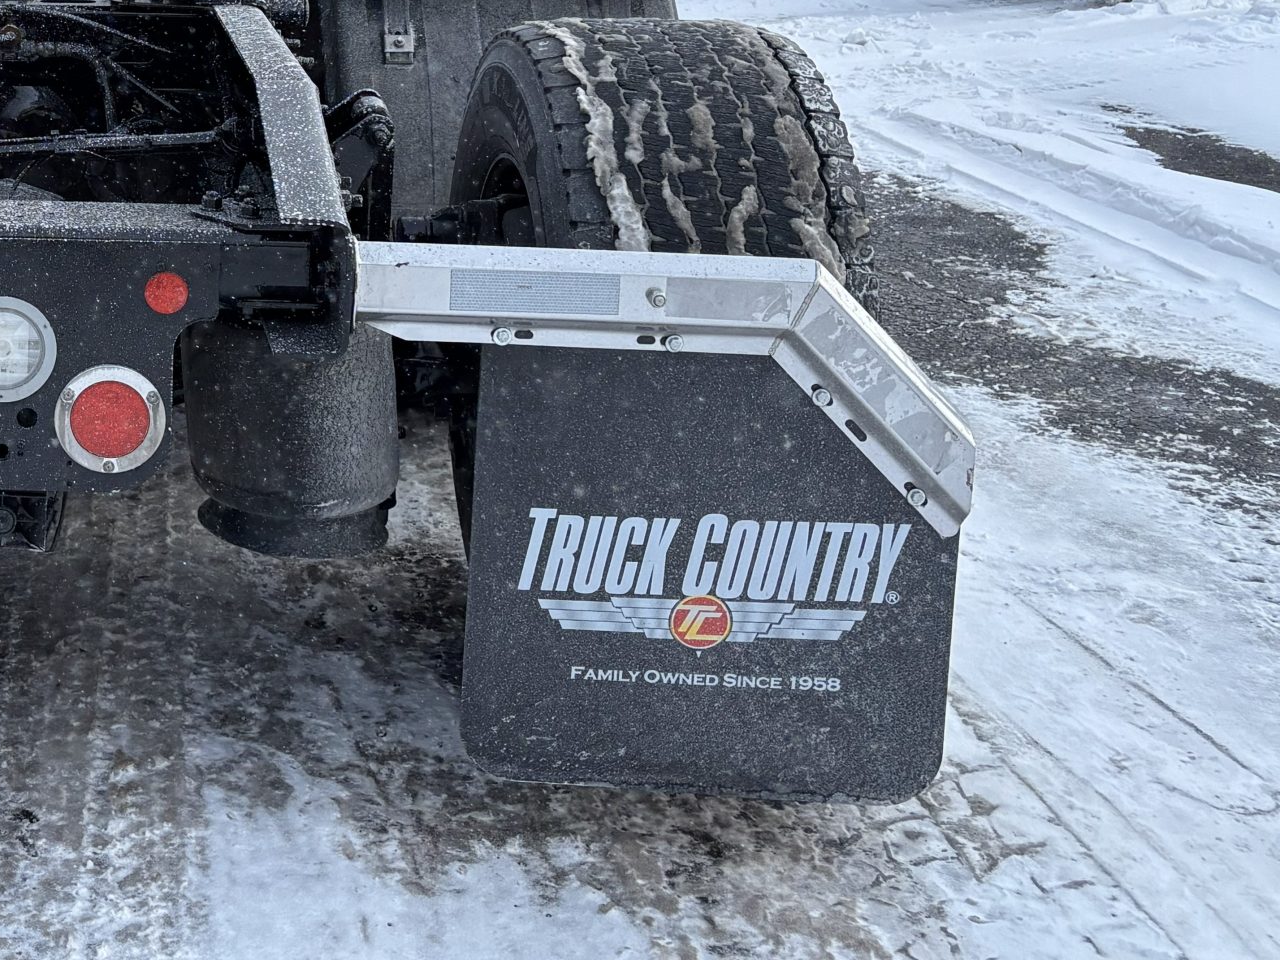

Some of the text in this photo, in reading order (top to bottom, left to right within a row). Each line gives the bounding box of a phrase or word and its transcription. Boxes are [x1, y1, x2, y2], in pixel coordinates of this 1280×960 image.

[517, 507, 912, 605] TRUCK COUNTRY
[570, 666, 841, 692] FAMILY OWNED SINCE 1958
